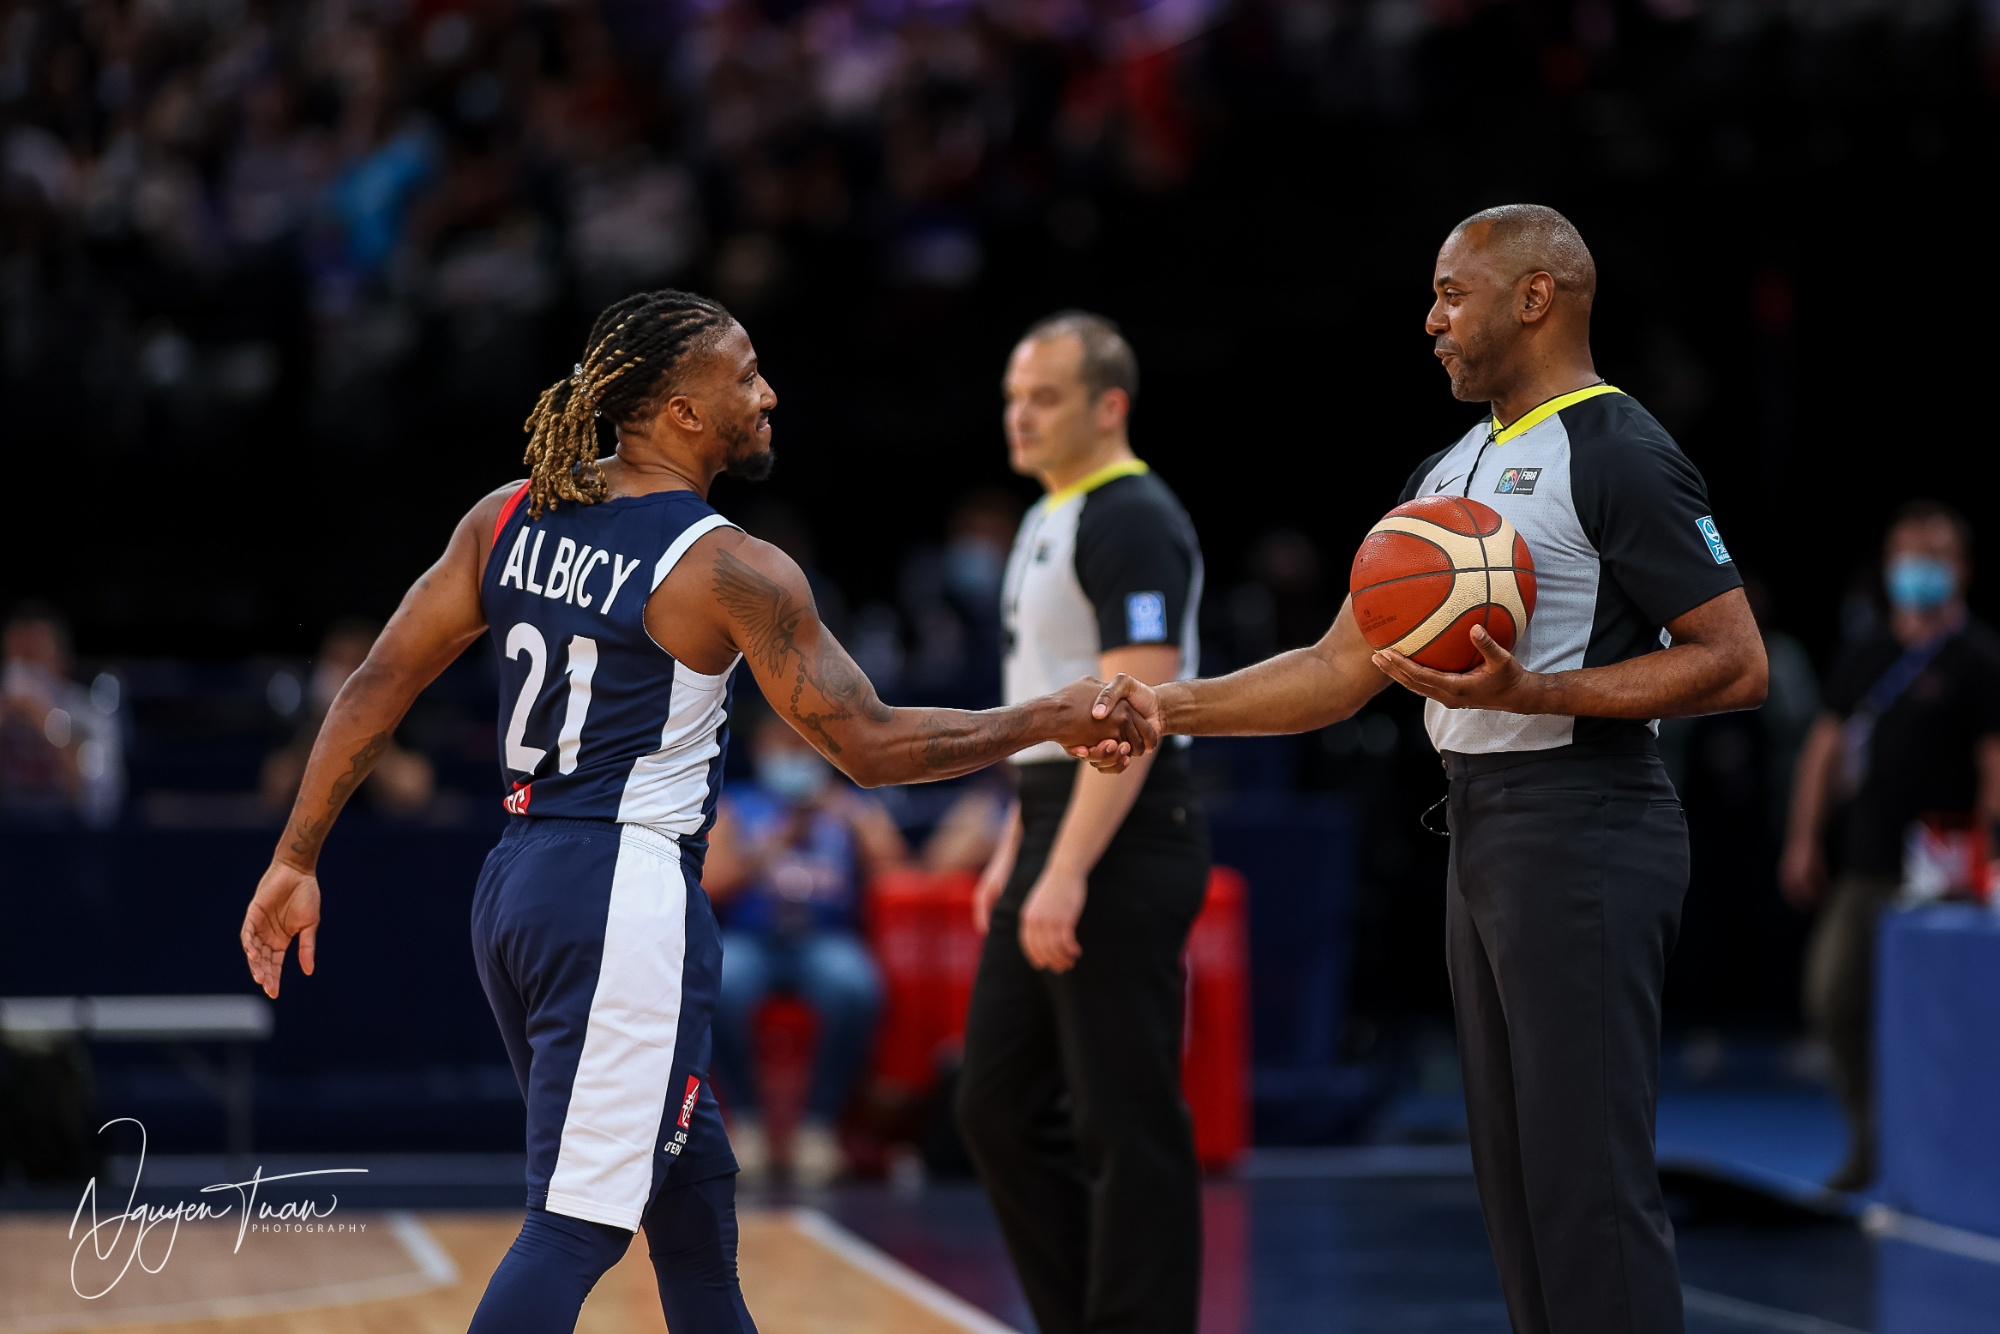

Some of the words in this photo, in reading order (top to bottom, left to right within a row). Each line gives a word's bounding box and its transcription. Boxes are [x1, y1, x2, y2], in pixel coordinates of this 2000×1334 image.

[1521, 471, 1537, 480] FIBA
[499, 525, 641, 616] ALBICY
[504, 622, 599, 776] 21
